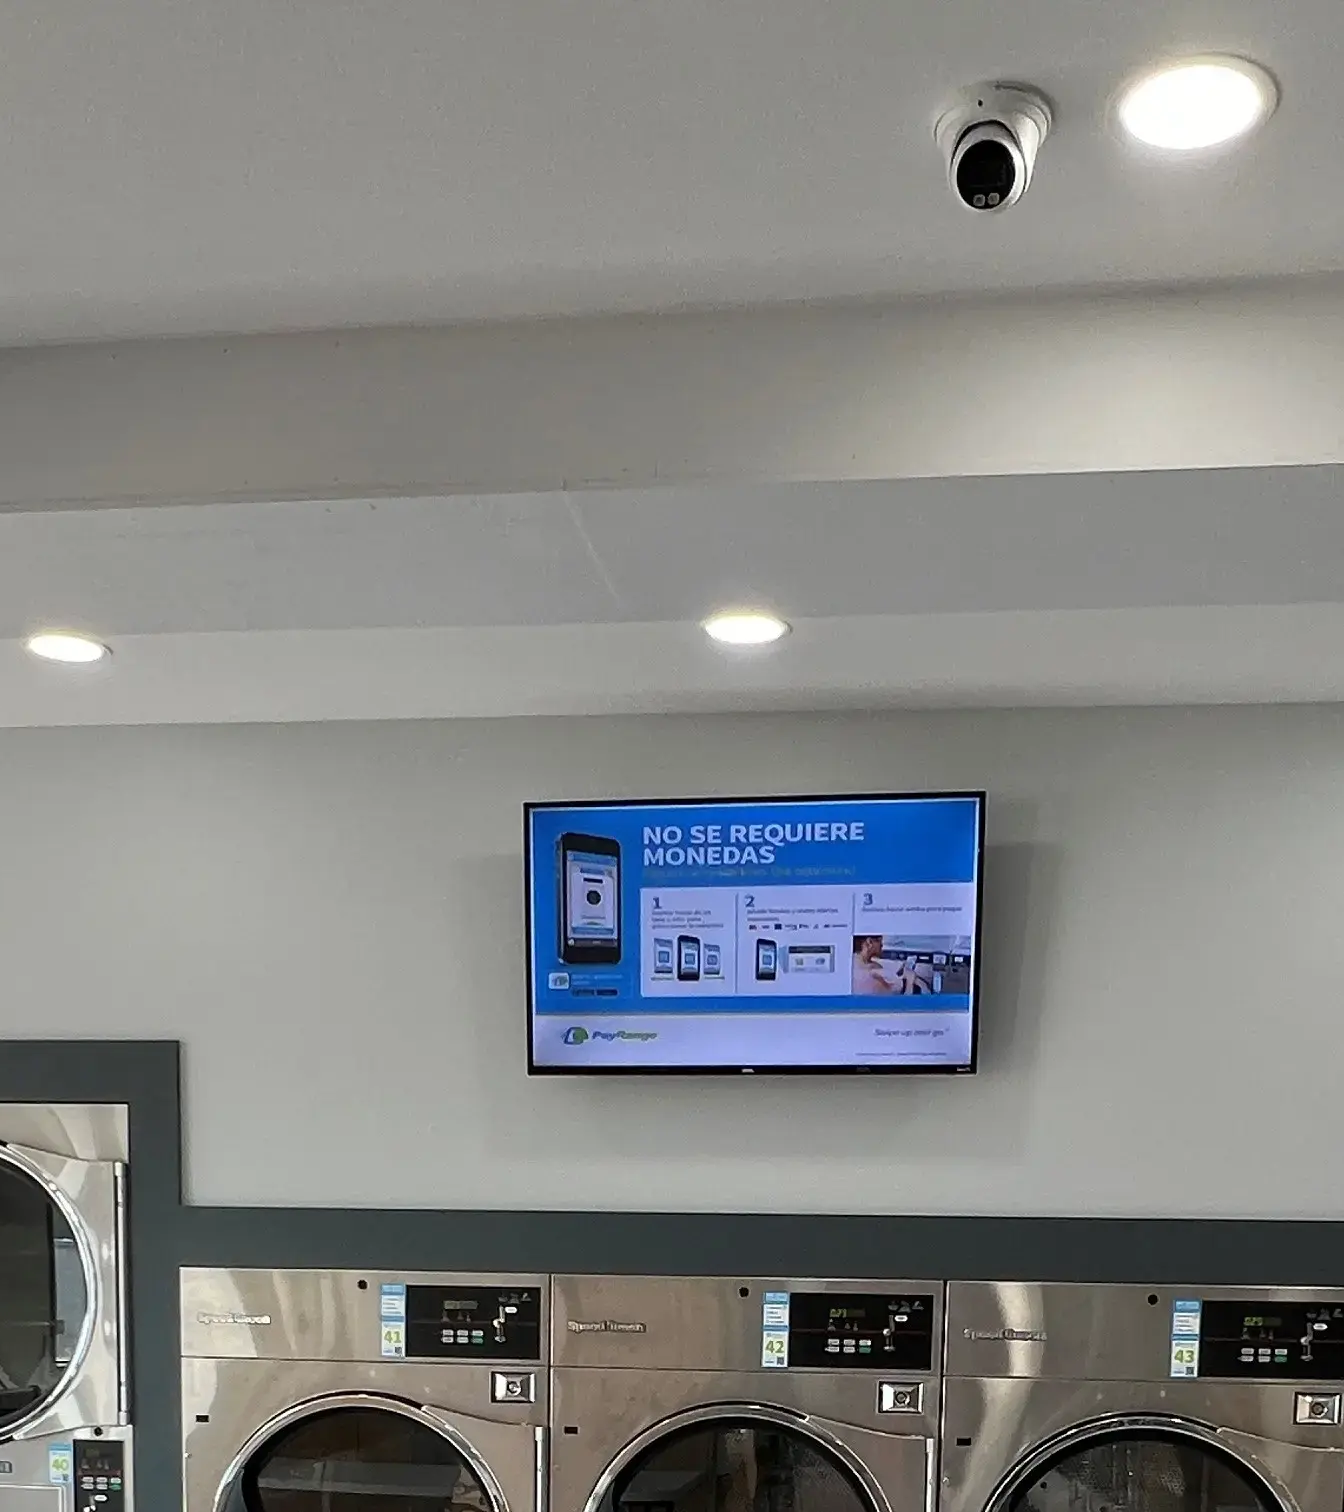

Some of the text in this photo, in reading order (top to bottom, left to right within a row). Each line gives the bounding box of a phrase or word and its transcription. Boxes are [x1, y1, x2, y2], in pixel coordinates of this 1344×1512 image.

[643, 822, 865, 846] NO SE REQUIERE
[643, 846, 775, 866] MONEDAS
[652, 897, 662, 909] 1
[744, 895, 755, 908] 2
[863, 892, 873, 905] 3
[383, 1331, 402, 1344] 41
[765, 1340, 785, 1354] 42
[1174, 1350, 1195, 1363] 43
[51, 1458, 69, 1471] 40
